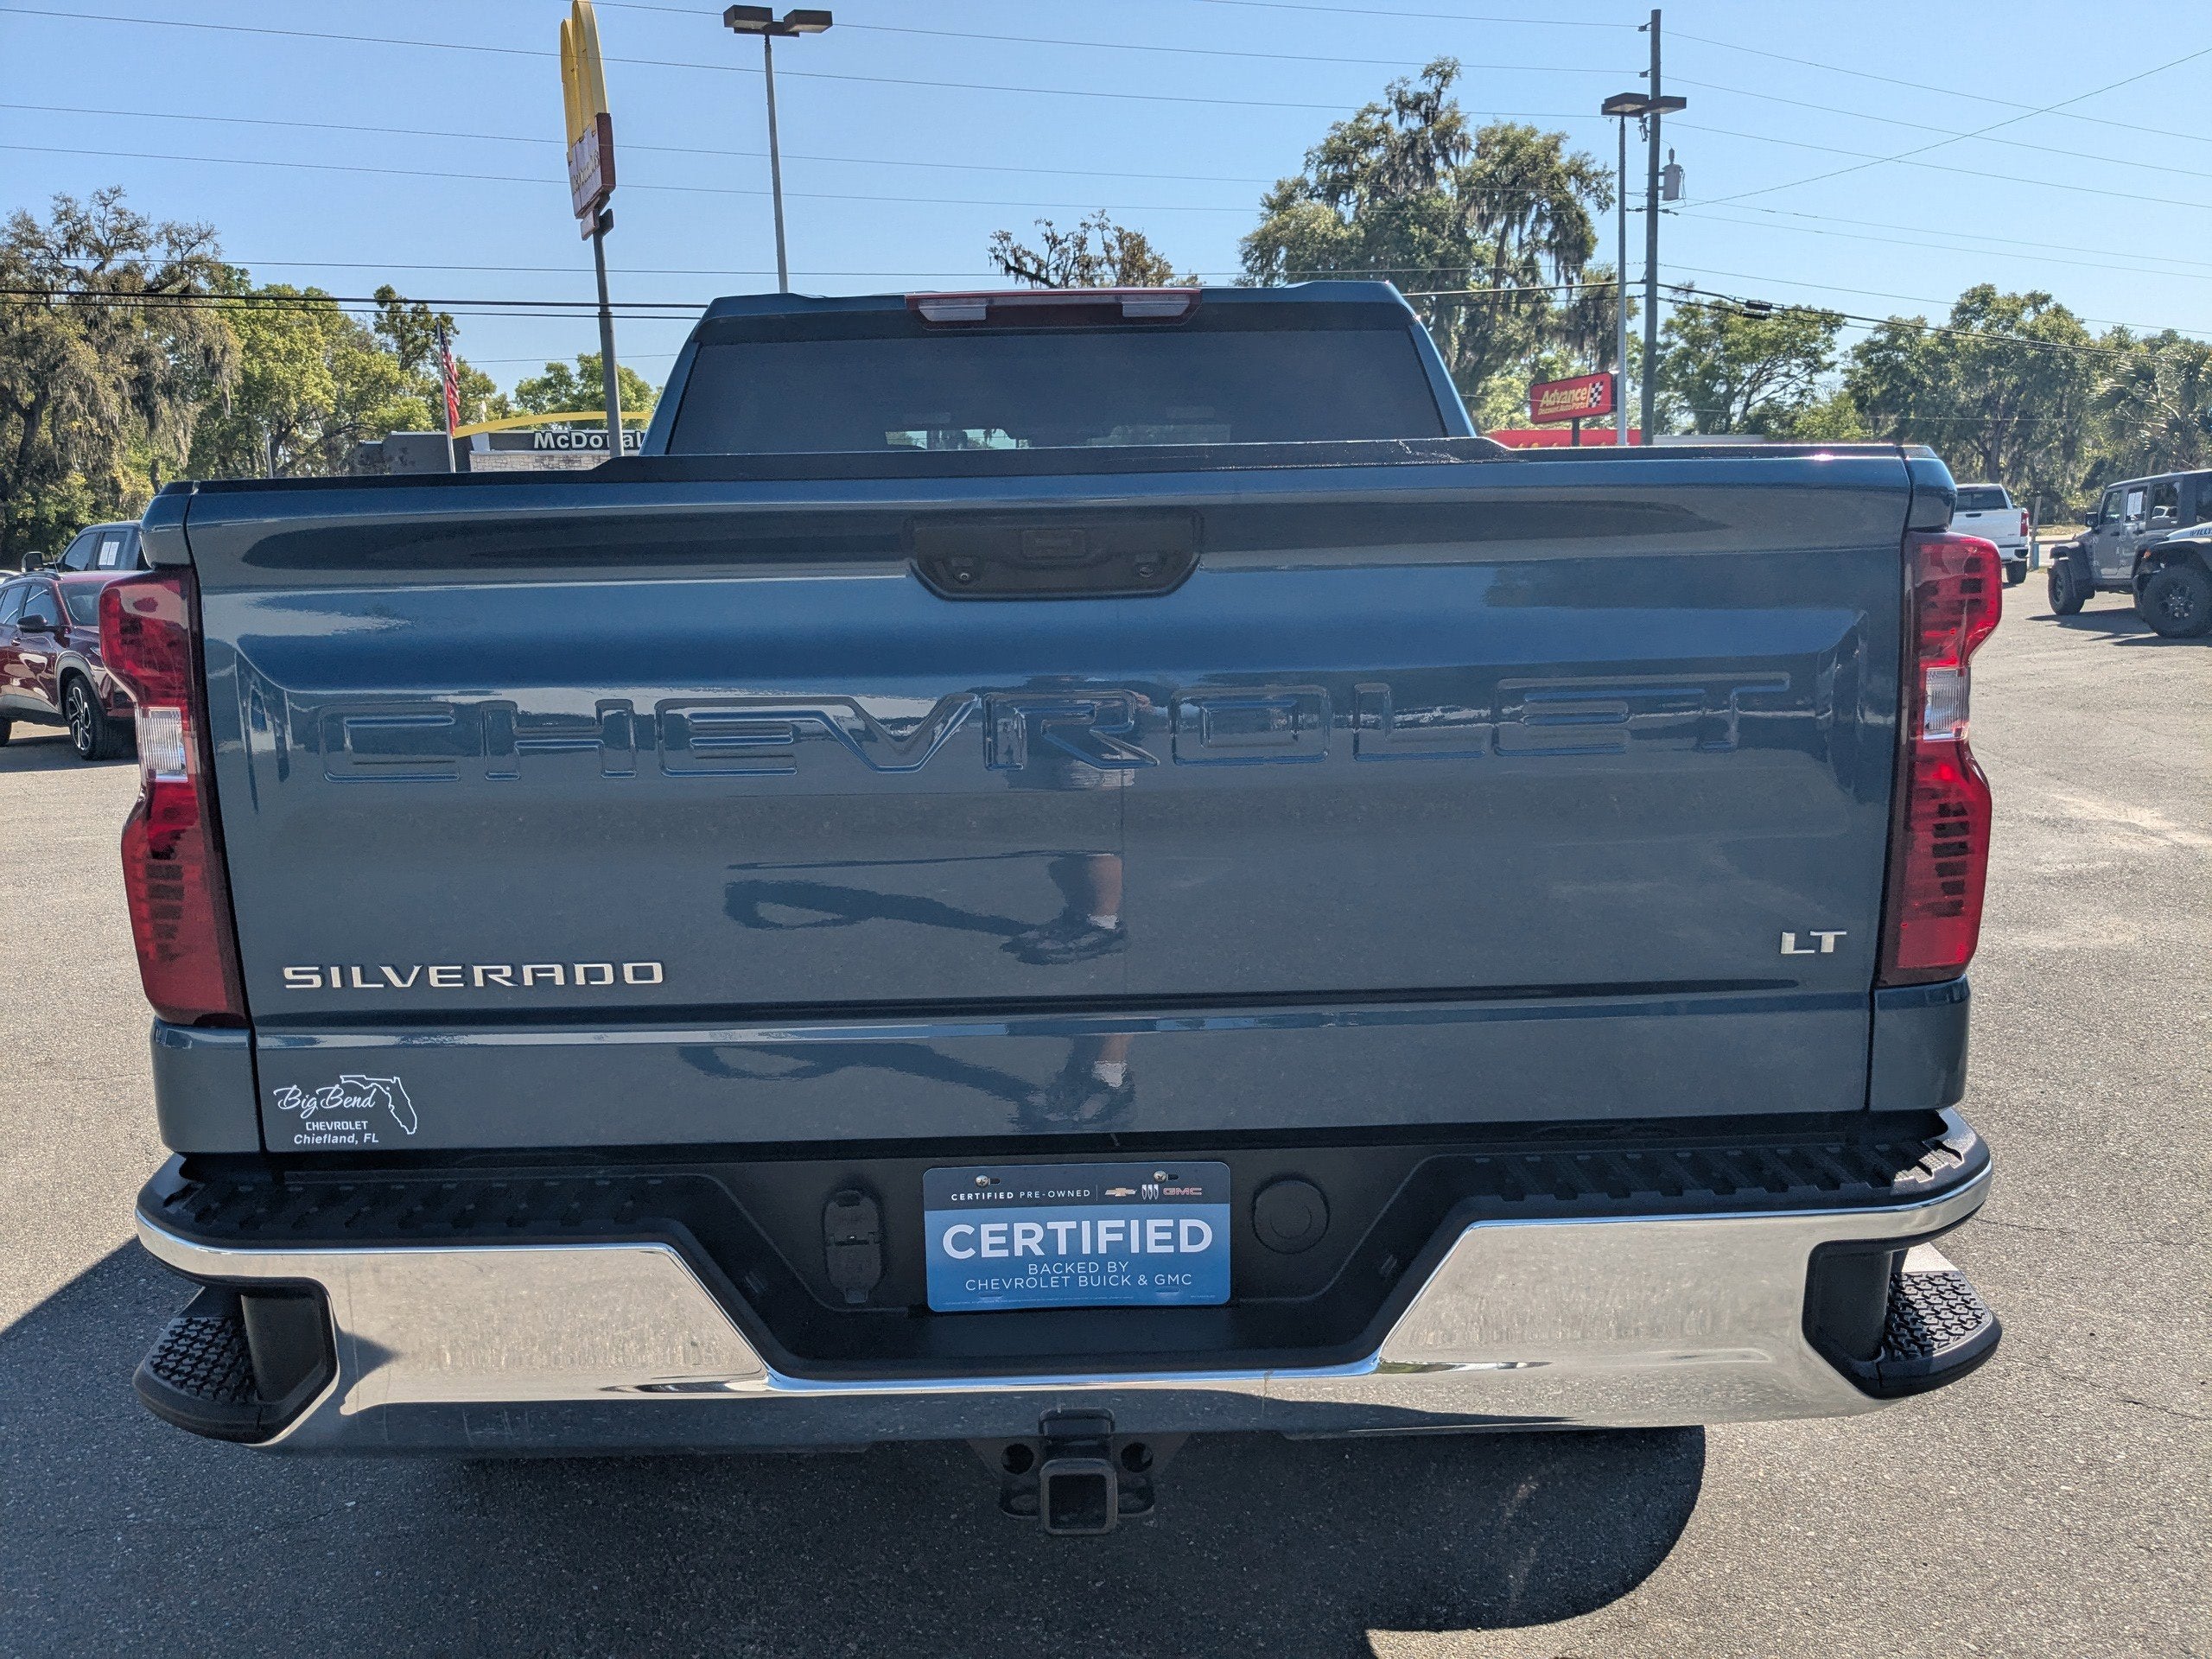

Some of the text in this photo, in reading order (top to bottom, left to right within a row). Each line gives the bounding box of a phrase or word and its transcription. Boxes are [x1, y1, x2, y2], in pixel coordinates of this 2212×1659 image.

[1540, 387, 1588, 408] Advance
[533, 430, 644, 450] McDoal
[320, 672, 1791, 784] CHEVROLET
[1780, 931, 1847, 954] LT
[283, 962, 664, 988] SILVERADO
[273, 1084, 378, 1119] Big Bend
[305, 1120, 369, 1131] CHEVROLET
[293, 1132, 379, 1146] Chiefland, FL
[950, 1189, 1091, 1202] CERTIFIED PRE-OWNED
[1162, 1186, 1203, 1197] GMC
[942, 1218, 1213, 1260] CERTIFIED
[1027, 1261, 1129, 1275] BACKED BY
[965, 1274, 1192, 1291] CHEVROLET BUICK & GMC
